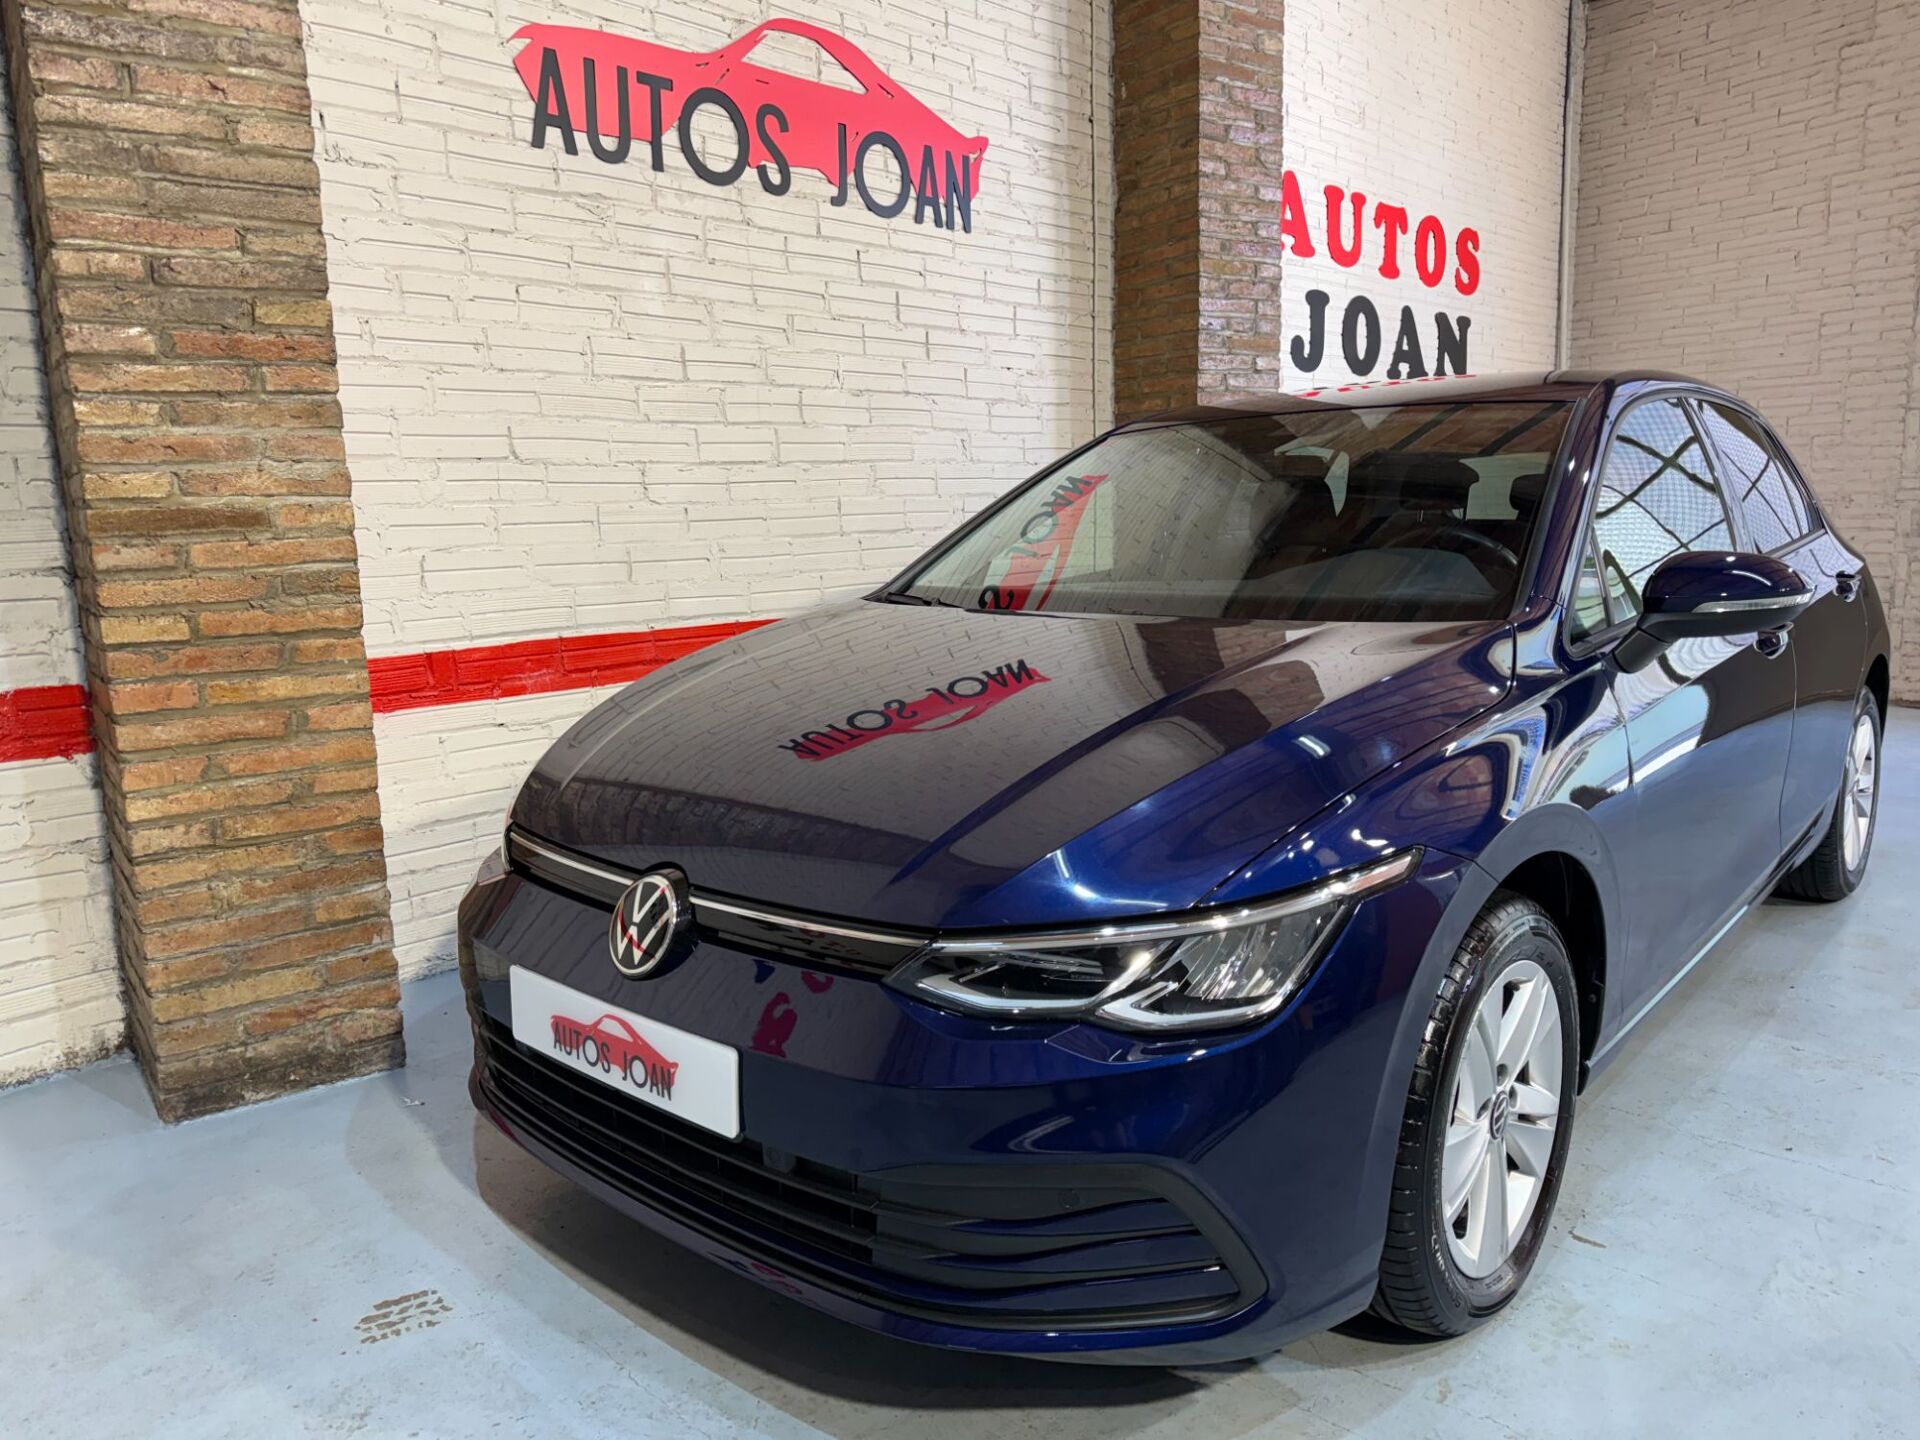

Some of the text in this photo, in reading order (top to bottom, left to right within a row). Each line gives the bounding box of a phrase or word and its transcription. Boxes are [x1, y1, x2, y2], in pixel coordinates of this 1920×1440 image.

[531, 47, 973, 233] AUTOS JOAN
[1280, 170, 1481, 296] AUTOS
[1290, 289, 1472, 380] JOAN
[553, 1021, 672, 1101] AUTOS JOAN
